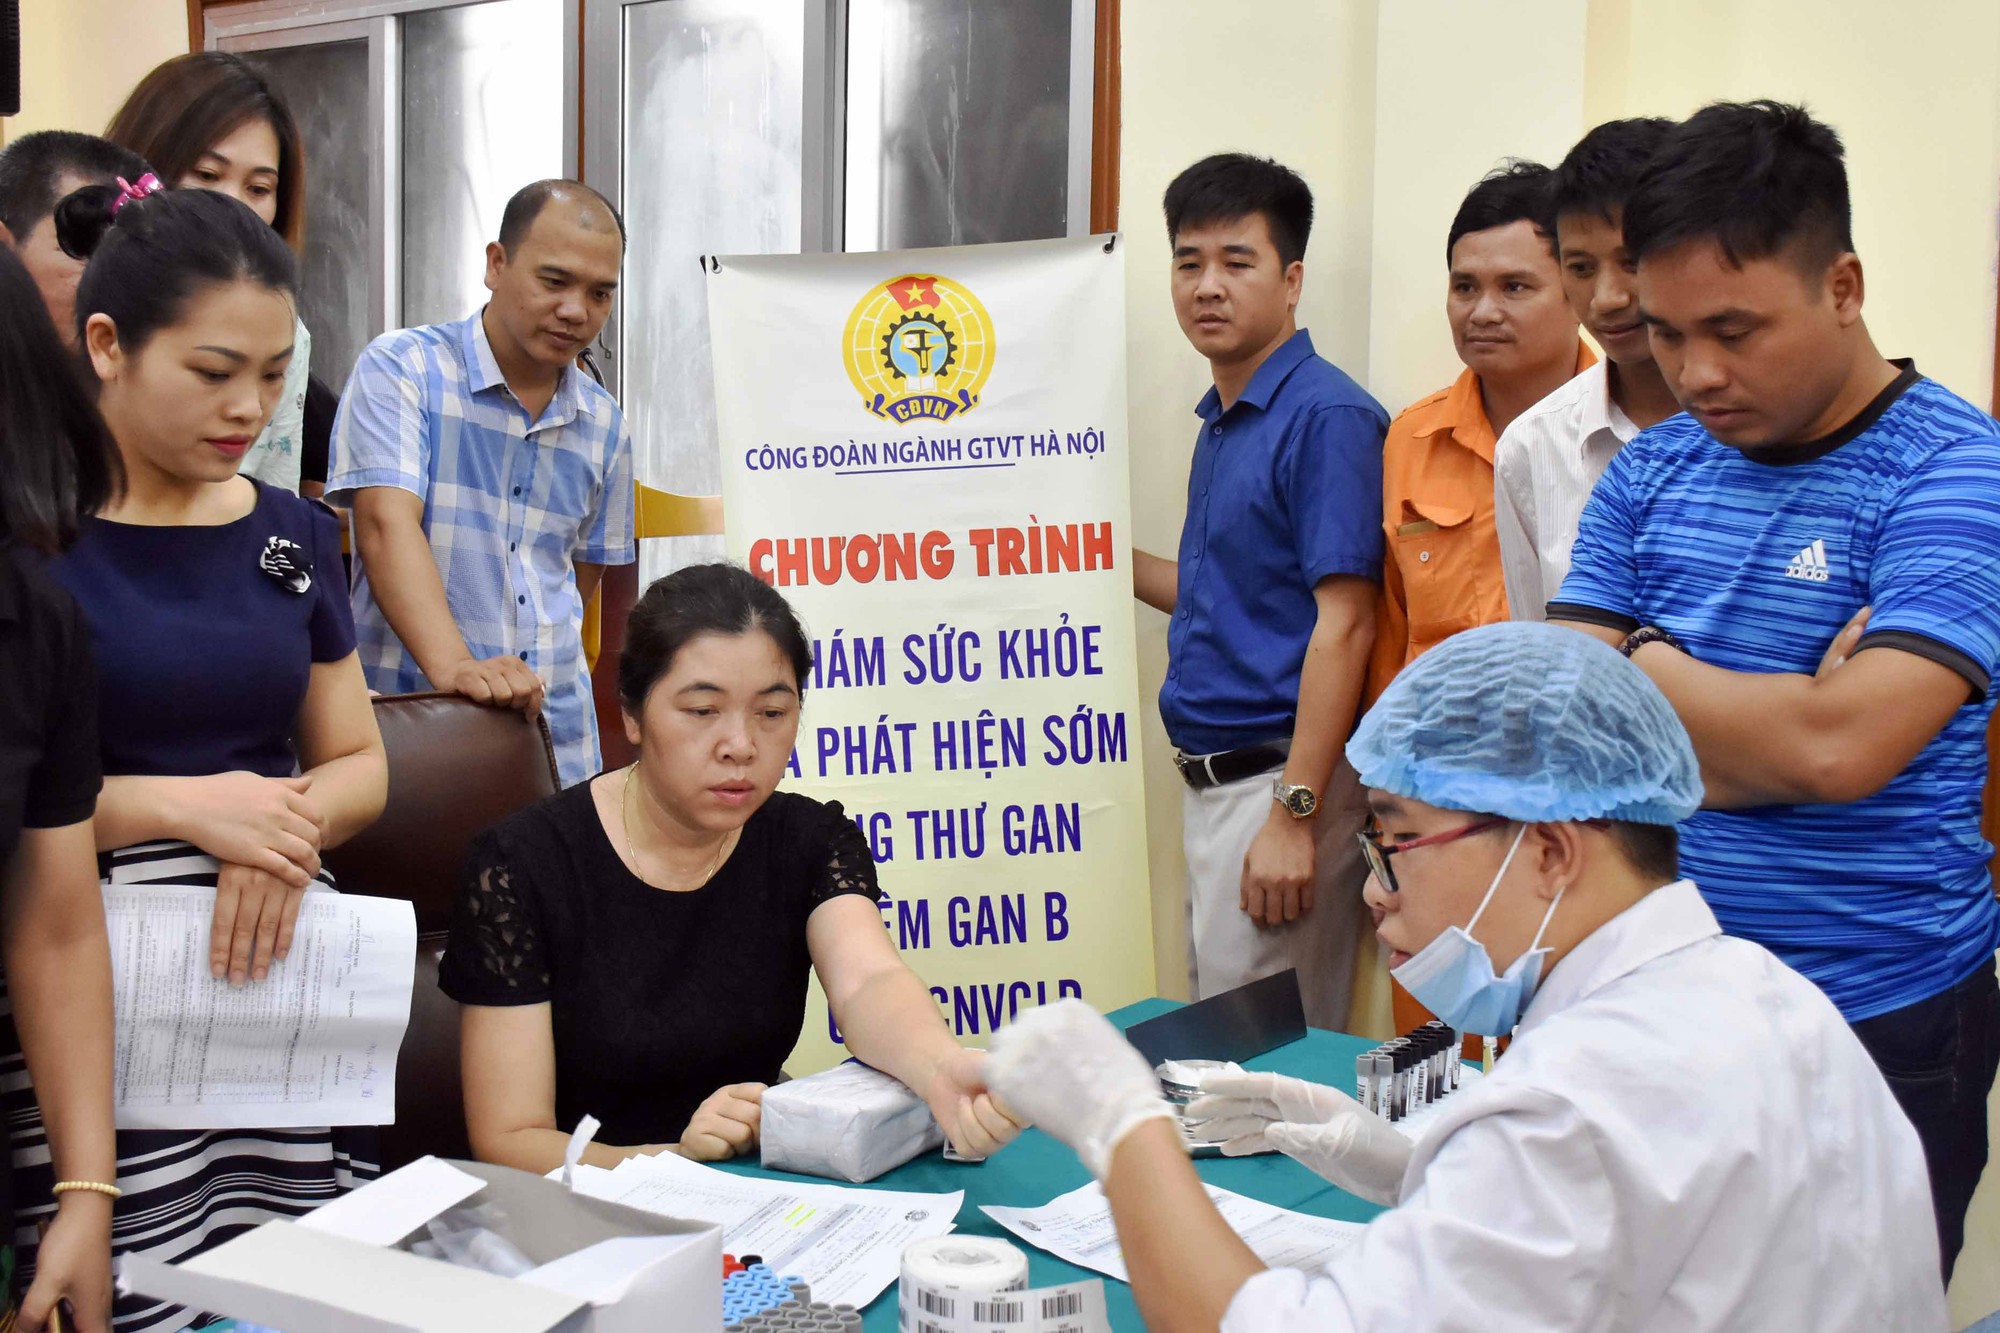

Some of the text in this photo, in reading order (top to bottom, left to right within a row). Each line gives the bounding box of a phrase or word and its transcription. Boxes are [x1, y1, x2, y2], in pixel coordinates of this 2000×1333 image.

[895, 398, 949, 420] CĐVN
[745, 427, 1105, 471] CÔNG ĐOÀN NGÀNH GTVT HÀ NỘI
[749, 514, 1114, 587] CHƯƠNG TRÌNH
[1785, 564, 1829, 581] adidas
[803, 612, 1104, 690] HÁM SỨC KHỎE
[817, 714, 917, 777] PHÁT
[932, 709, 1027, 779] HIỆN
[1043, 704, 1128, 766] SỚM
[906, 801, 987, 861] THƯ
[1002, 802, 1082, 857] GAN
[947, 894, 1027, 948] GAN
[1044, 891, 1069, 942] B
